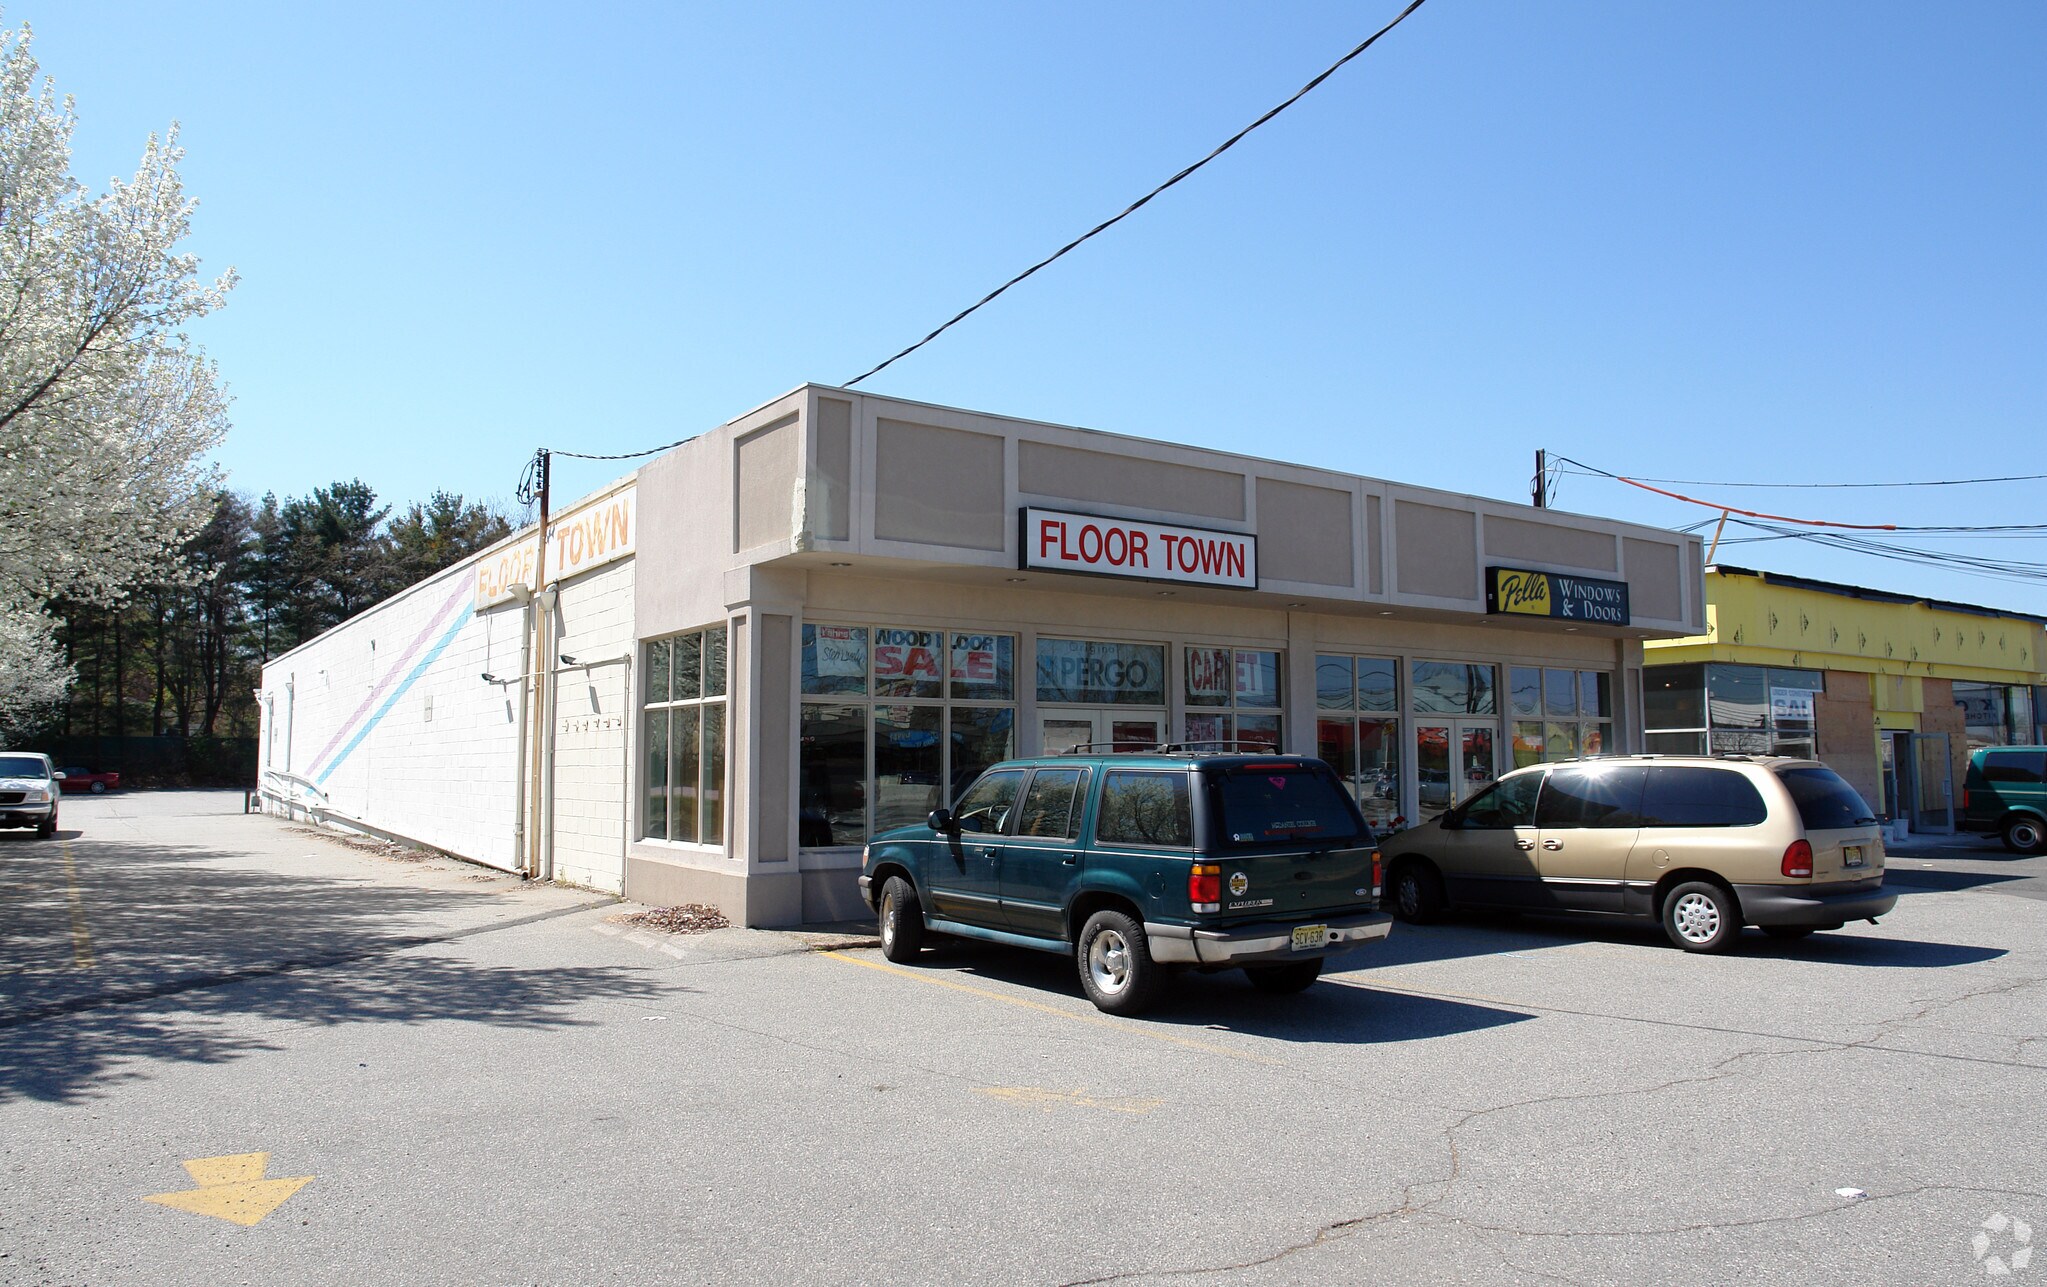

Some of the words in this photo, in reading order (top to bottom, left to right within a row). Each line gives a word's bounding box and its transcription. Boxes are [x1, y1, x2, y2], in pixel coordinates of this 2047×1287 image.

[479, 543, 535, 599] FLOOR
[556, 498, 630, 571] TOWN
[1040, 519, 1149, 569] FLOOR
[1159, 534, 1246, 579] TOWN
[1500, 573, 1547, 613] Pella
[1562, 598, 1575, 617] &
[1583, 600, 1623, 622] DOORS
[875, 629, 932, 649] WOOD
[936, 632, 994, 652] OOR
[875, 646, 994, 680] SALE
[1061, 656, 1148, 688] PERGO
[1190, 648, 1258, 692] CARET
[1774, 699, 1808, 717] SAL
